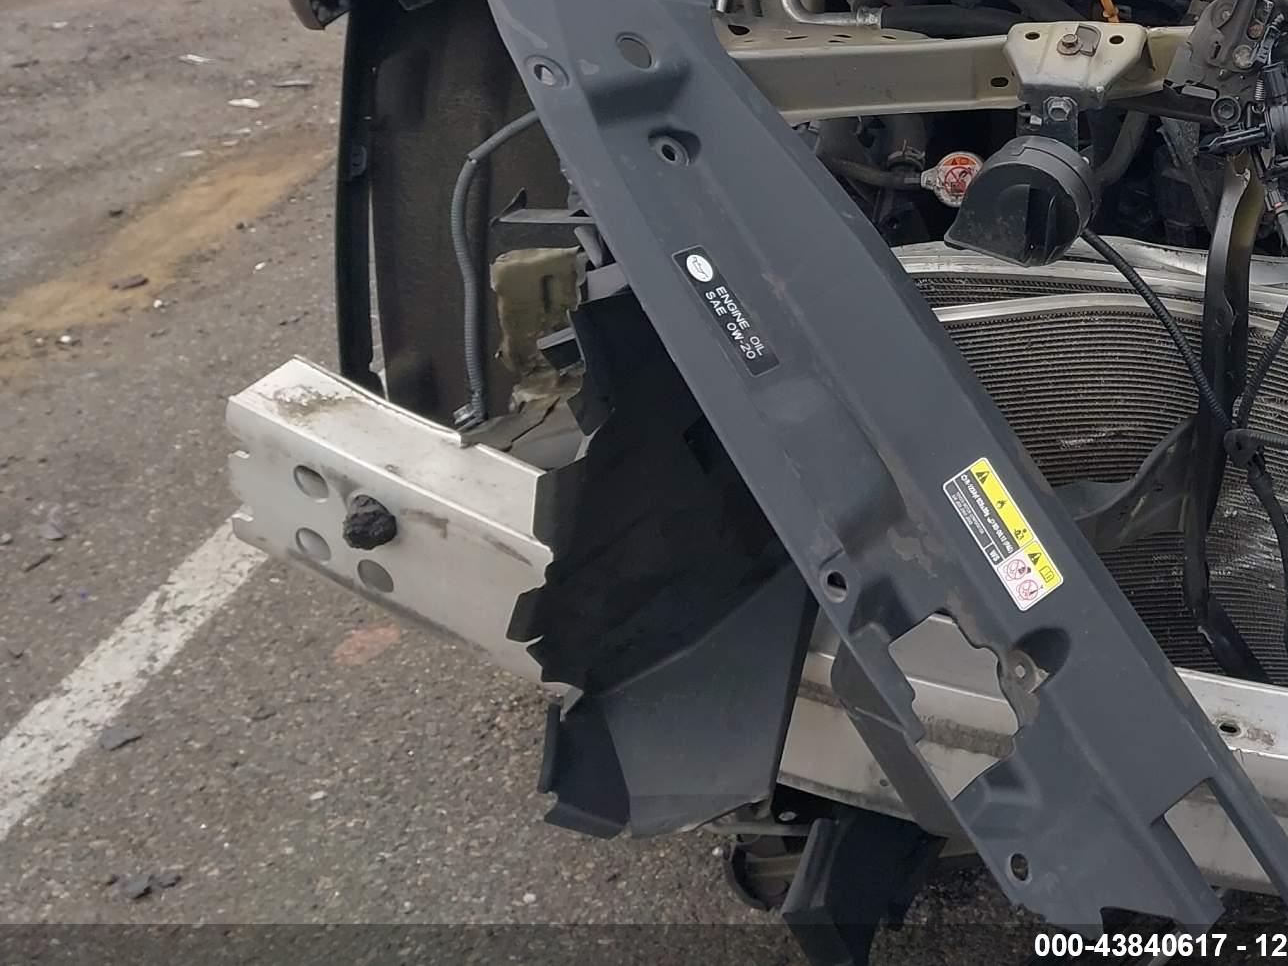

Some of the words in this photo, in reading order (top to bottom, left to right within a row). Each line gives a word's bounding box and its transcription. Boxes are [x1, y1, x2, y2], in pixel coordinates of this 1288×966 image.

[705, 291, 727, 317] SAE
[715, 286, 750, 330] ENGINE
[749, 336, 765, 356] OIL
[989, 549, 1000, 562] WS
